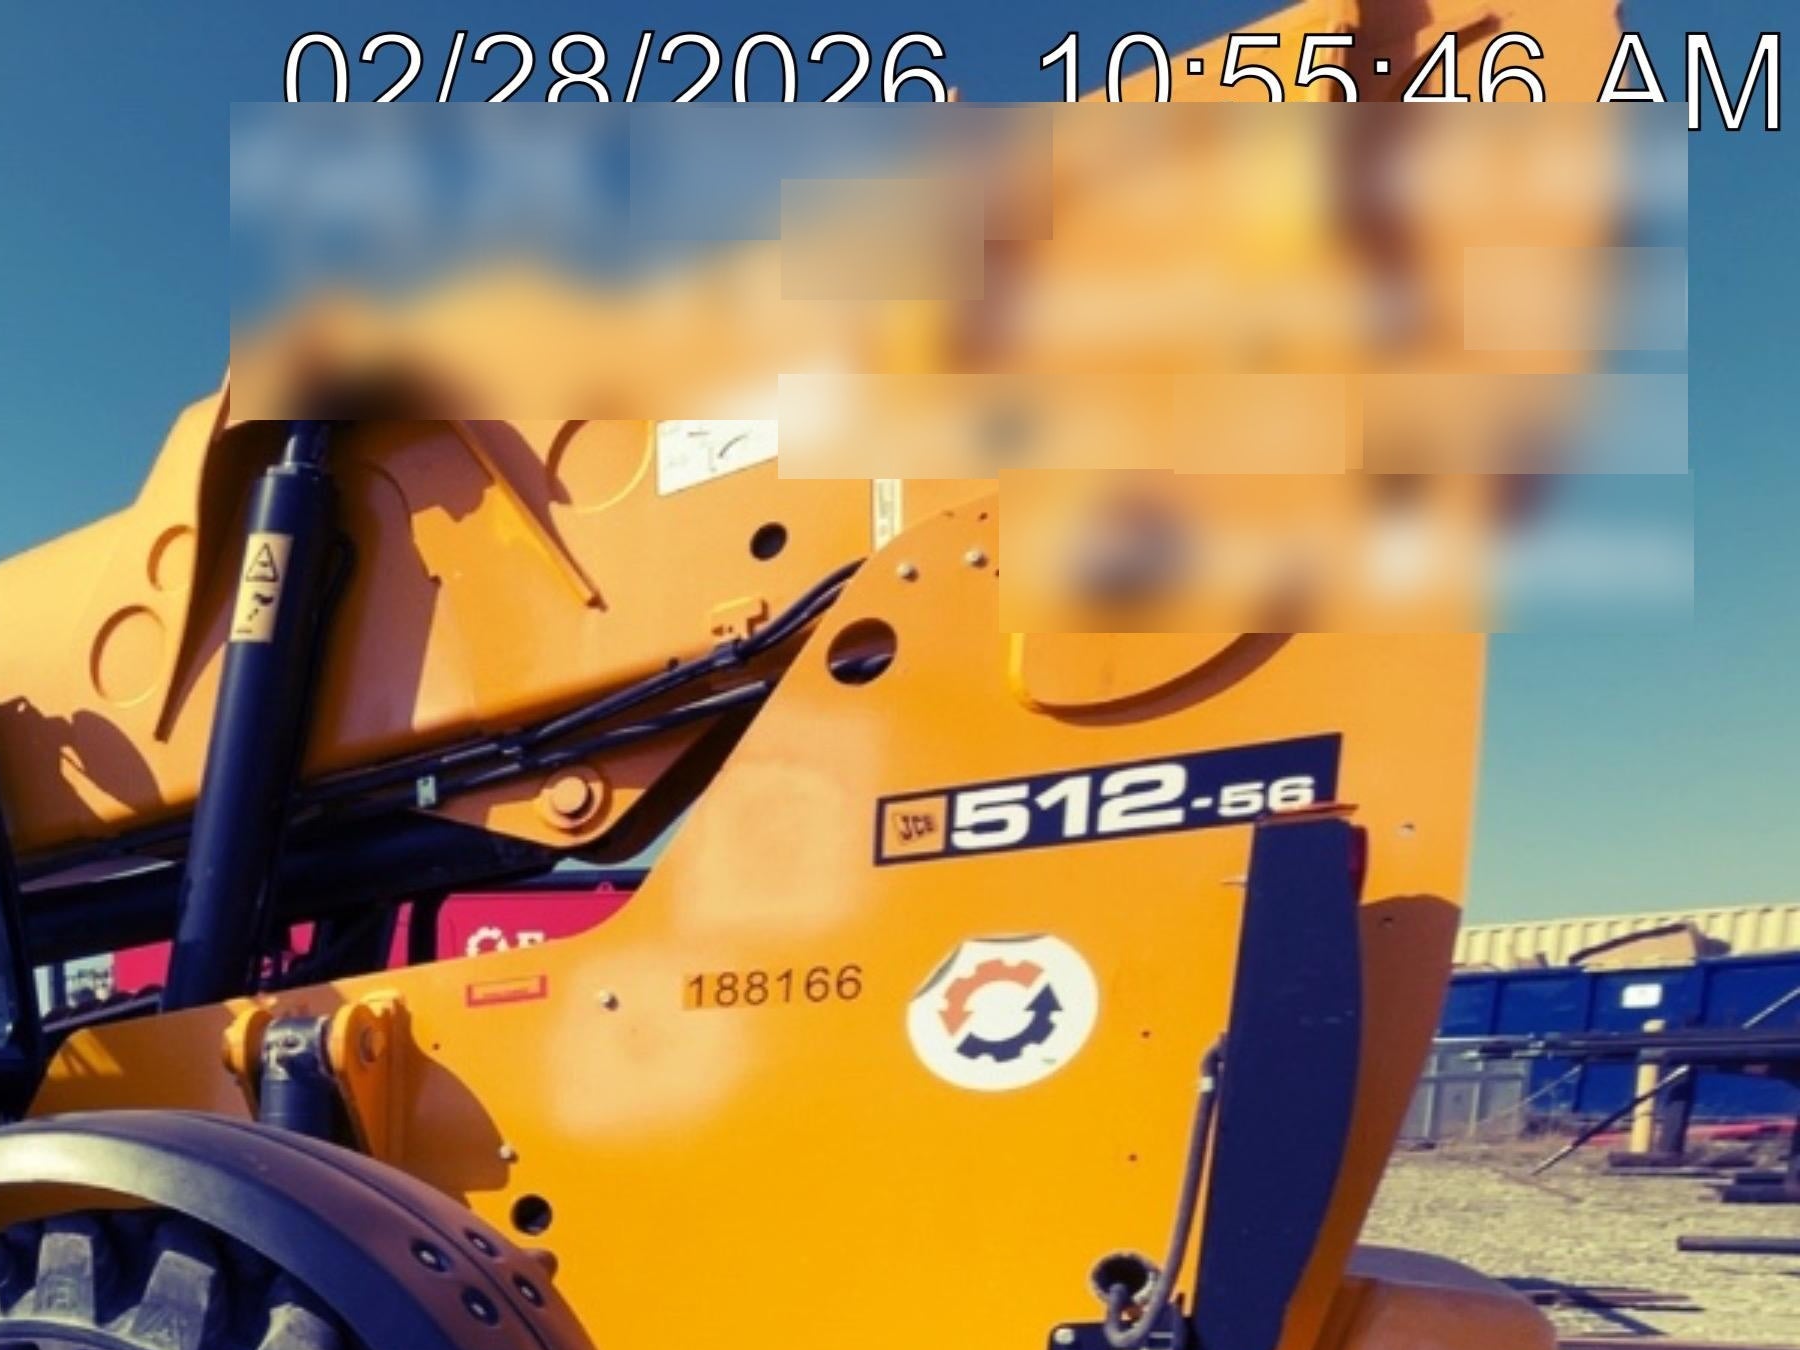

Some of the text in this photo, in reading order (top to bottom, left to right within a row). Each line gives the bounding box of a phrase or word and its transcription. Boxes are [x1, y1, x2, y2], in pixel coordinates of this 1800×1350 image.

[898, 763, 1316, 850] JCB 512-56
[688, 964, 863, 1009] 188166
